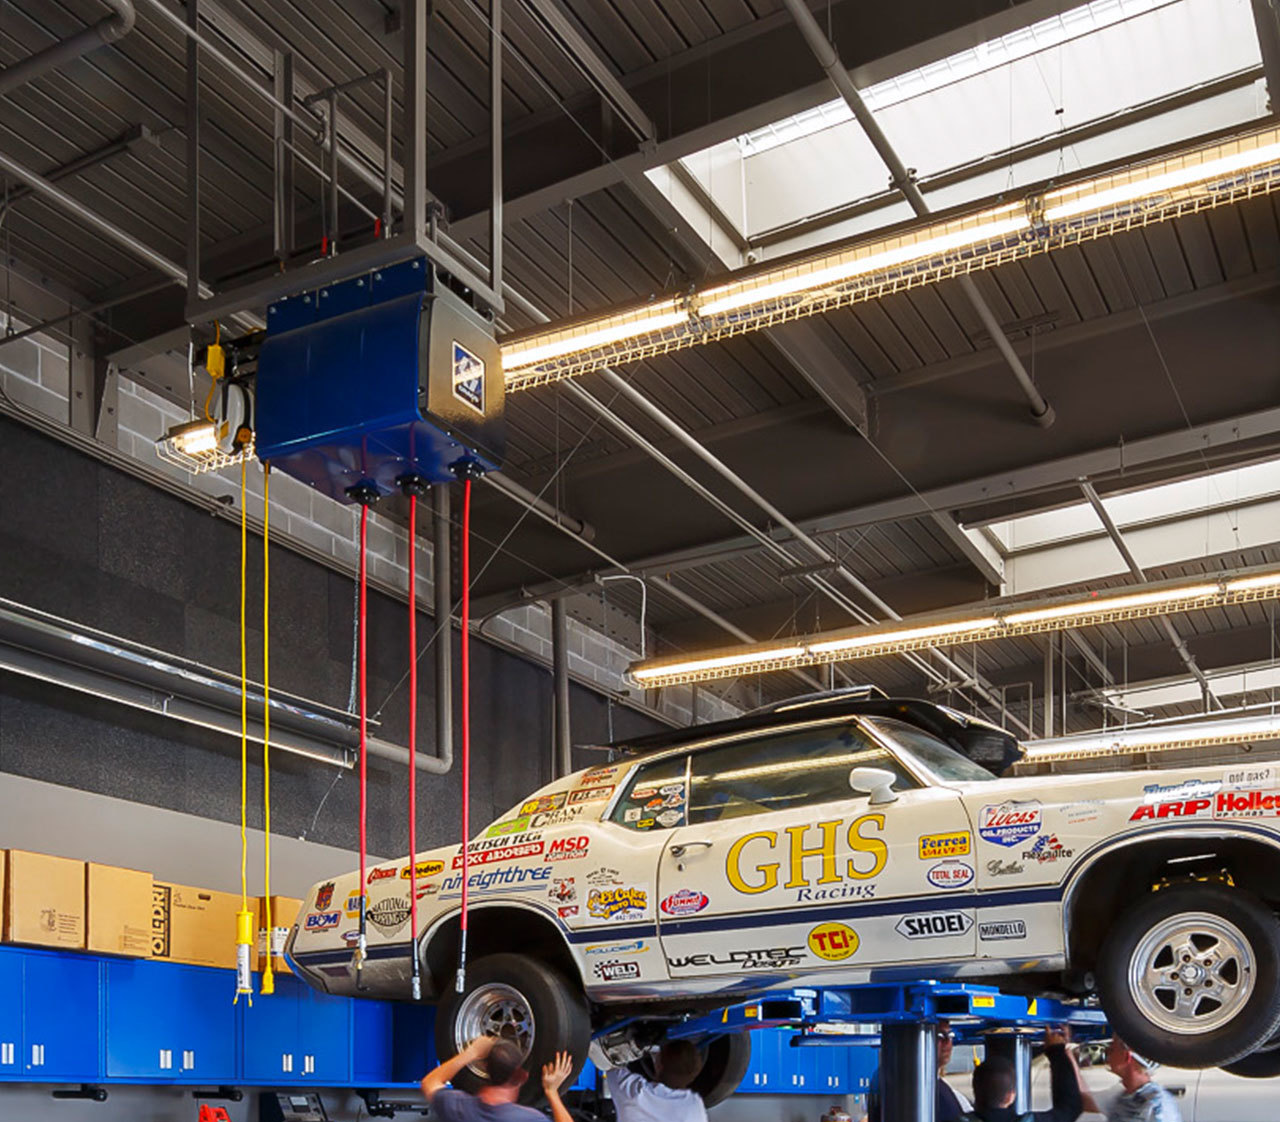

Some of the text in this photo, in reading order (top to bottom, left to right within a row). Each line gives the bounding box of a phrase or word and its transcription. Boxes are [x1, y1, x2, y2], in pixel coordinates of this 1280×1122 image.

[1129, 799, 1212, 821] ARP
[986, 810, 1039, 827] LUCAS
[981, 824, 1039, 837] OIL PRODUCTS
[549, 835, 590, 854] MSD
[921, 834, 968, 850] Ferrea
[1002, 835, 1020, 844] INC.
[725, 813, 889, 895] GHS
[922, 846, 968, 858] VALVES
[931, 868, 969, 880] TOTAL SEAL
[797, 882, 878, 902] Racing
[904, 914, 965, 936] SHOEI
[981, 922, 1025, 936] MONDELLO
[812, 930, 850, 951] TCI
[669, 945, 808, 968] WELDTEC
[741, 957, 802, 970] Designs
[603, 963, 638, 977] WELD
